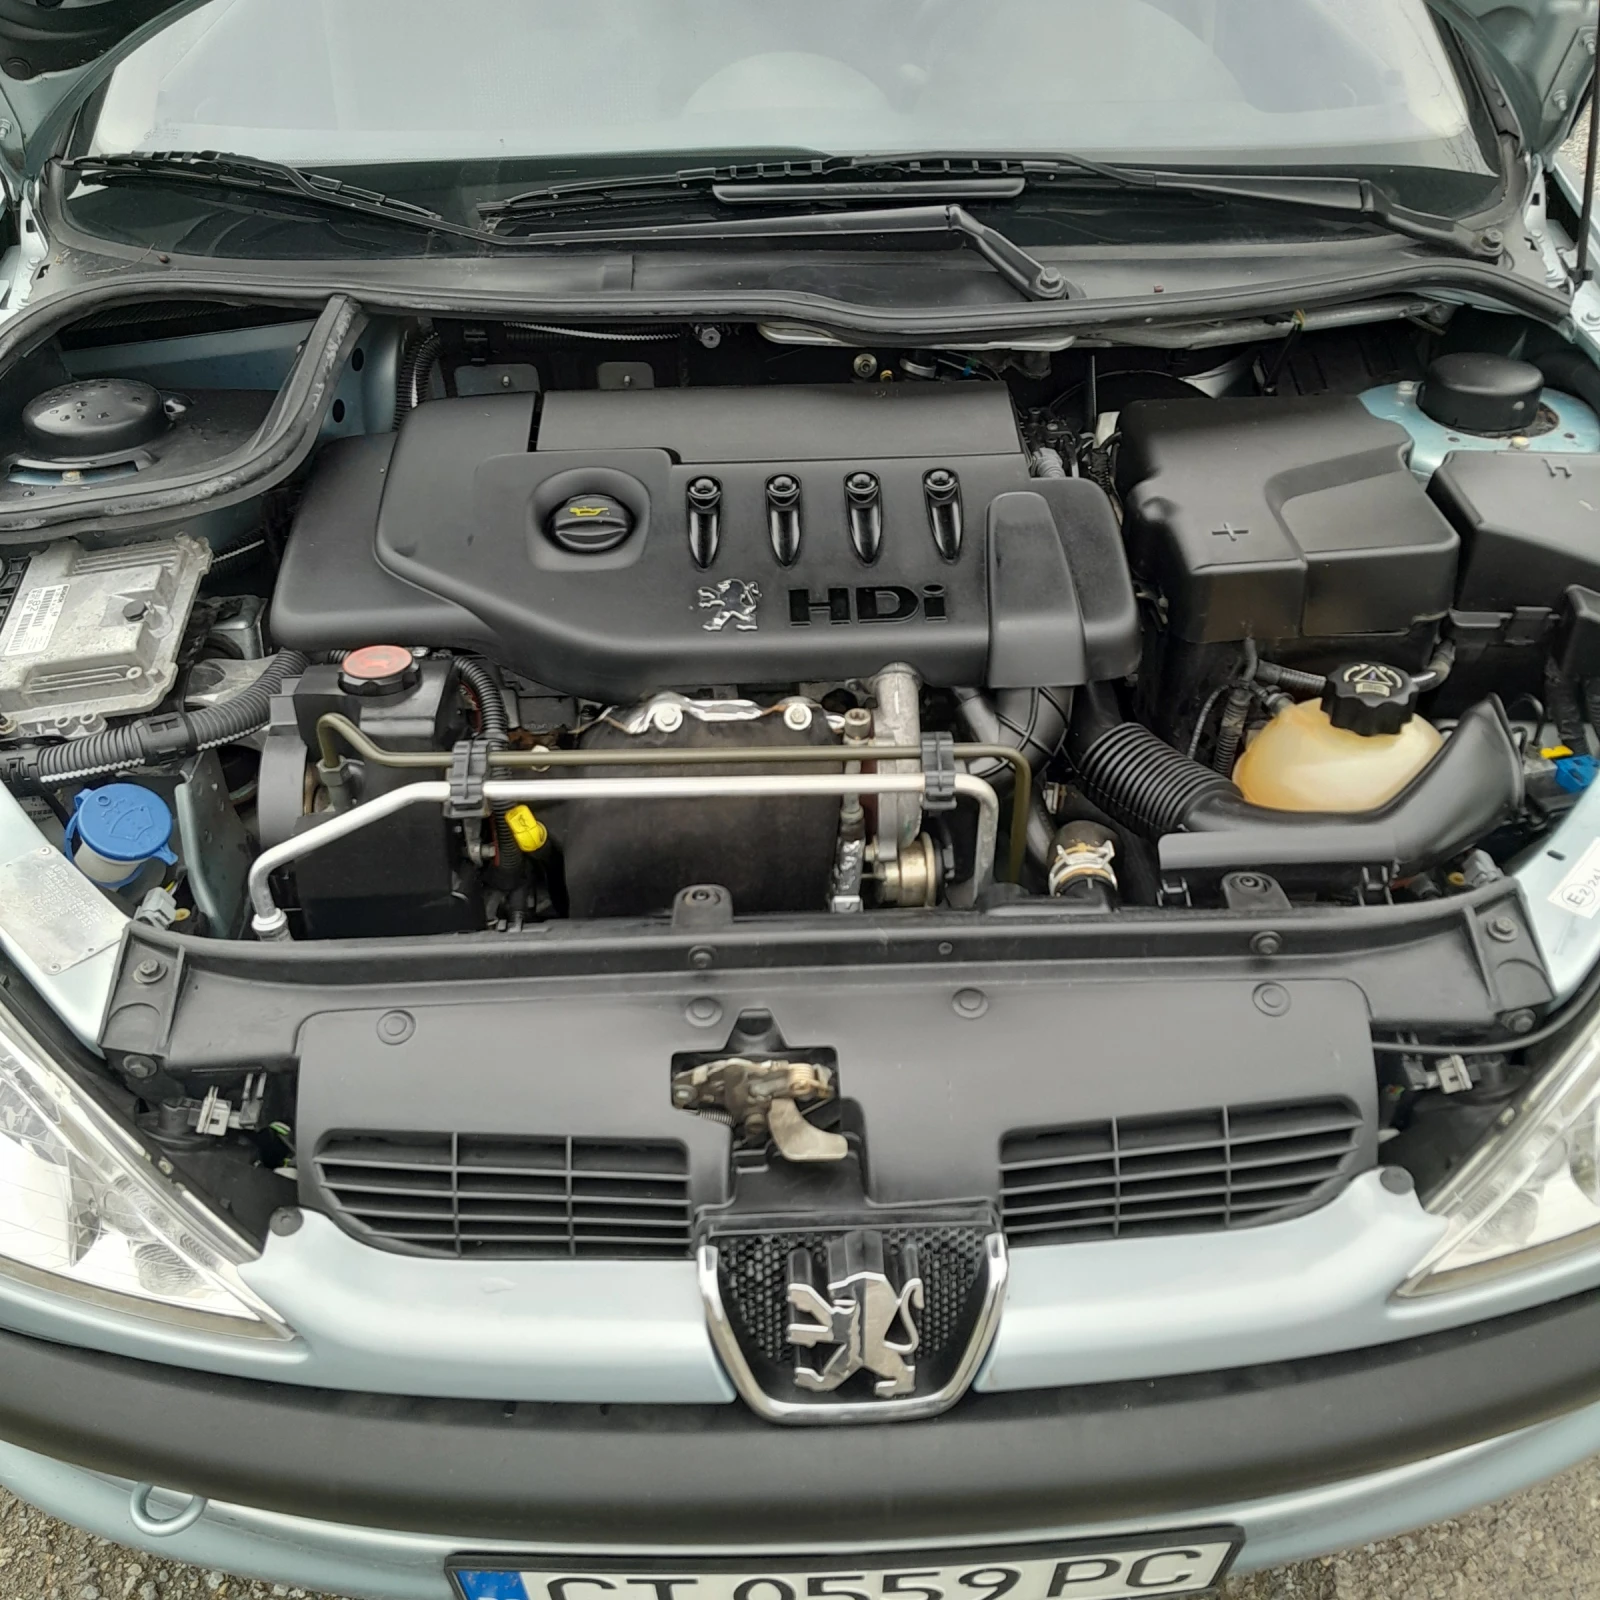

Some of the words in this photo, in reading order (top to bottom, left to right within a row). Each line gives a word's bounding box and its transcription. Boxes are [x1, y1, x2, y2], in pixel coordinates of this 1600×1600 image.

[788, 584, 947, 627] HDi
[546, 1576, 698, 1600] CT
[733, 1567, 1022, 1600] 0559
[1046, 1549, 1203, 1598] PC
